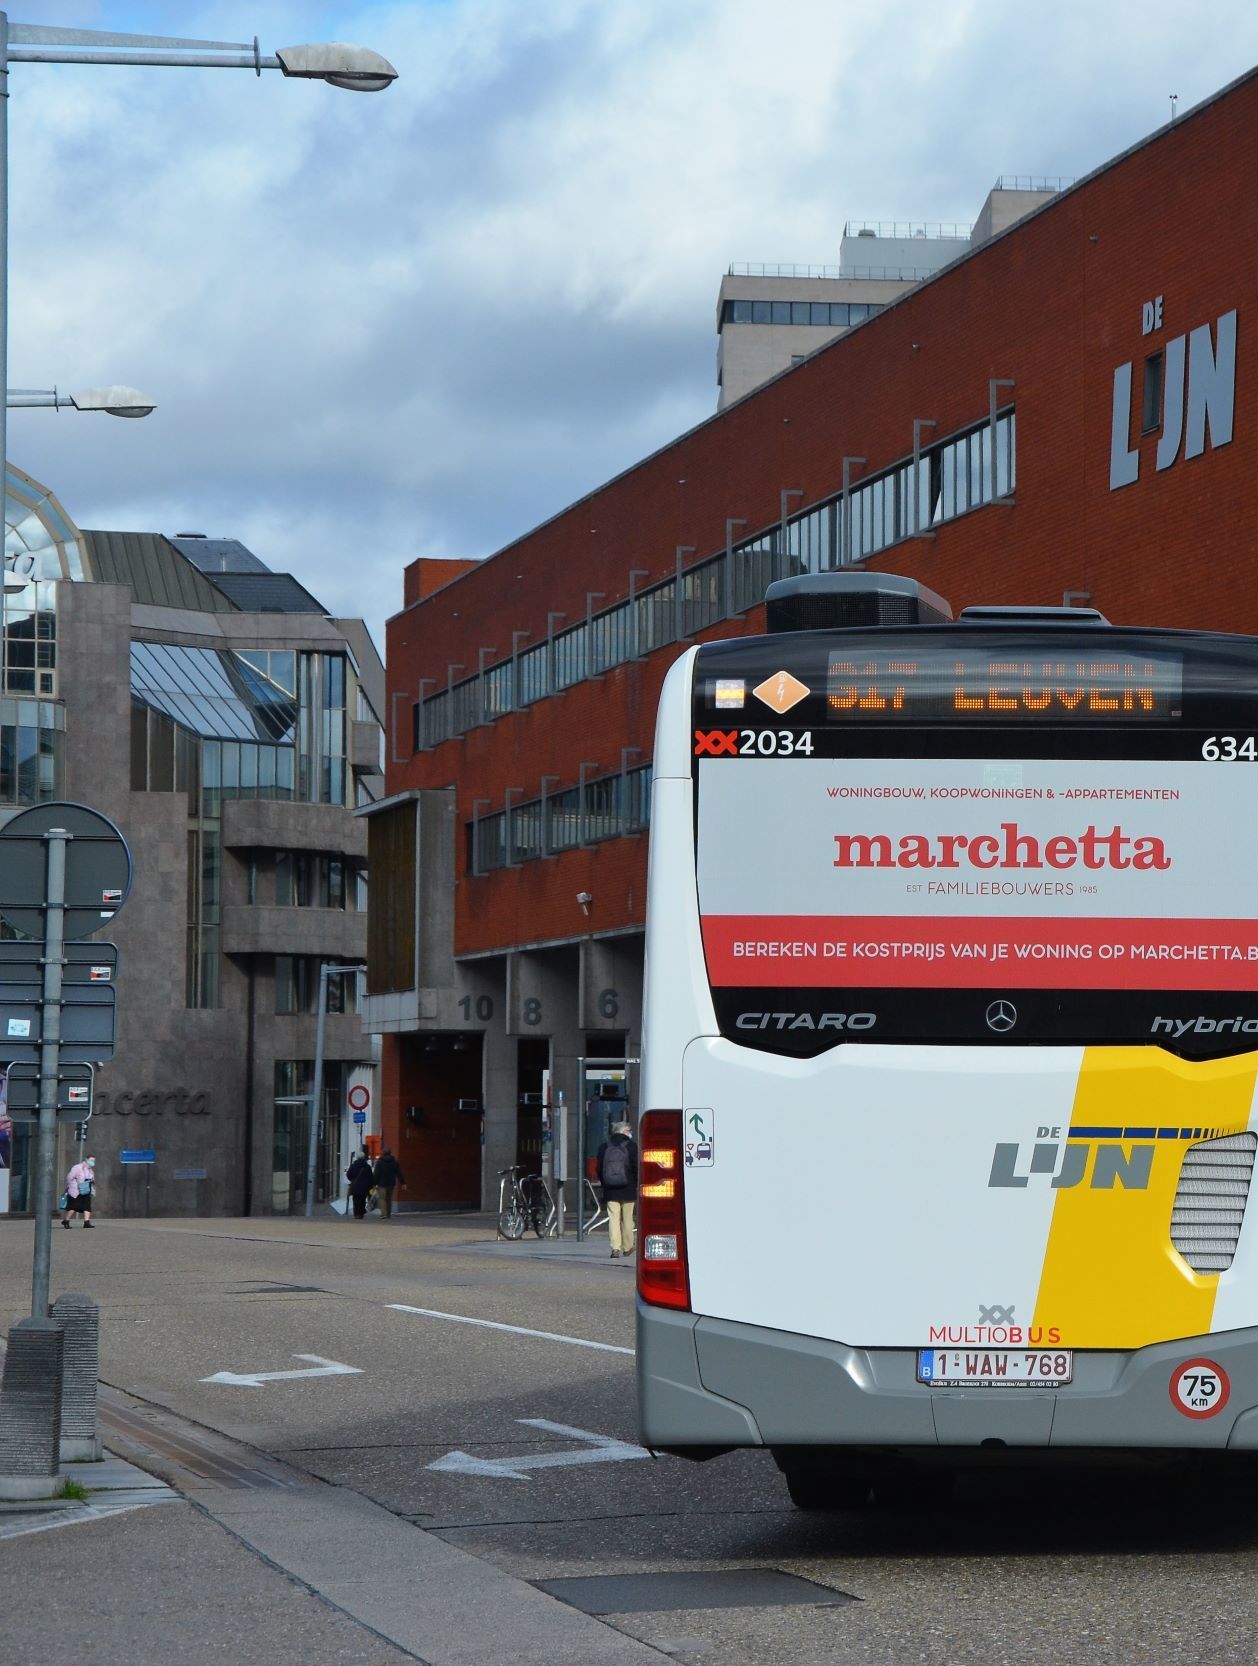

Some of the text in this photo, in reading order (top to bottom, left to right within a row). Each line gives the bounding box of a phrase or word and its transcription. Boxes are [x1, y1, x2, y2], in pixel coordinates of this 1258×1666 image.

[1142, 295, 1163, 336] DE
[955, 663, 1153, 709] LEUVEN
[827, 787, 1180, 800] WONINGBOUW, KOOPWONINGEN & -APPARTEMENTEN
[833, 823, 1172, 870] marchetta
[906, 881, 1098, 896] EST FAMILIEBOUWERS 1985
[733, 942, 817, 957] BEREKEN
[823, 943, 847, 957] DE
[852, 943, 945, 961] KOSTPRIJS
[950, 944, 986, 958] VAN
[990, 944, 1008, 961] JE
[1014, 944, 1092, 959] WONING
[1098, 945, 1124, 959] OP
[458, 995, 494, 1022] 10
[524, 998, 542, 1026] 8
[600, 988, 619, 1019] 6
[735, 1012, 877, 1030] CITARO
[1036, 1126, 1061, 1138] DE
[988, 1143, 1155, 1189] LIJN
[929, 1326, 1061, 1343] MULTIOBUS
[922, 1367, 931, 1377] B
[1184, 1376, 1216, 1396] 75
